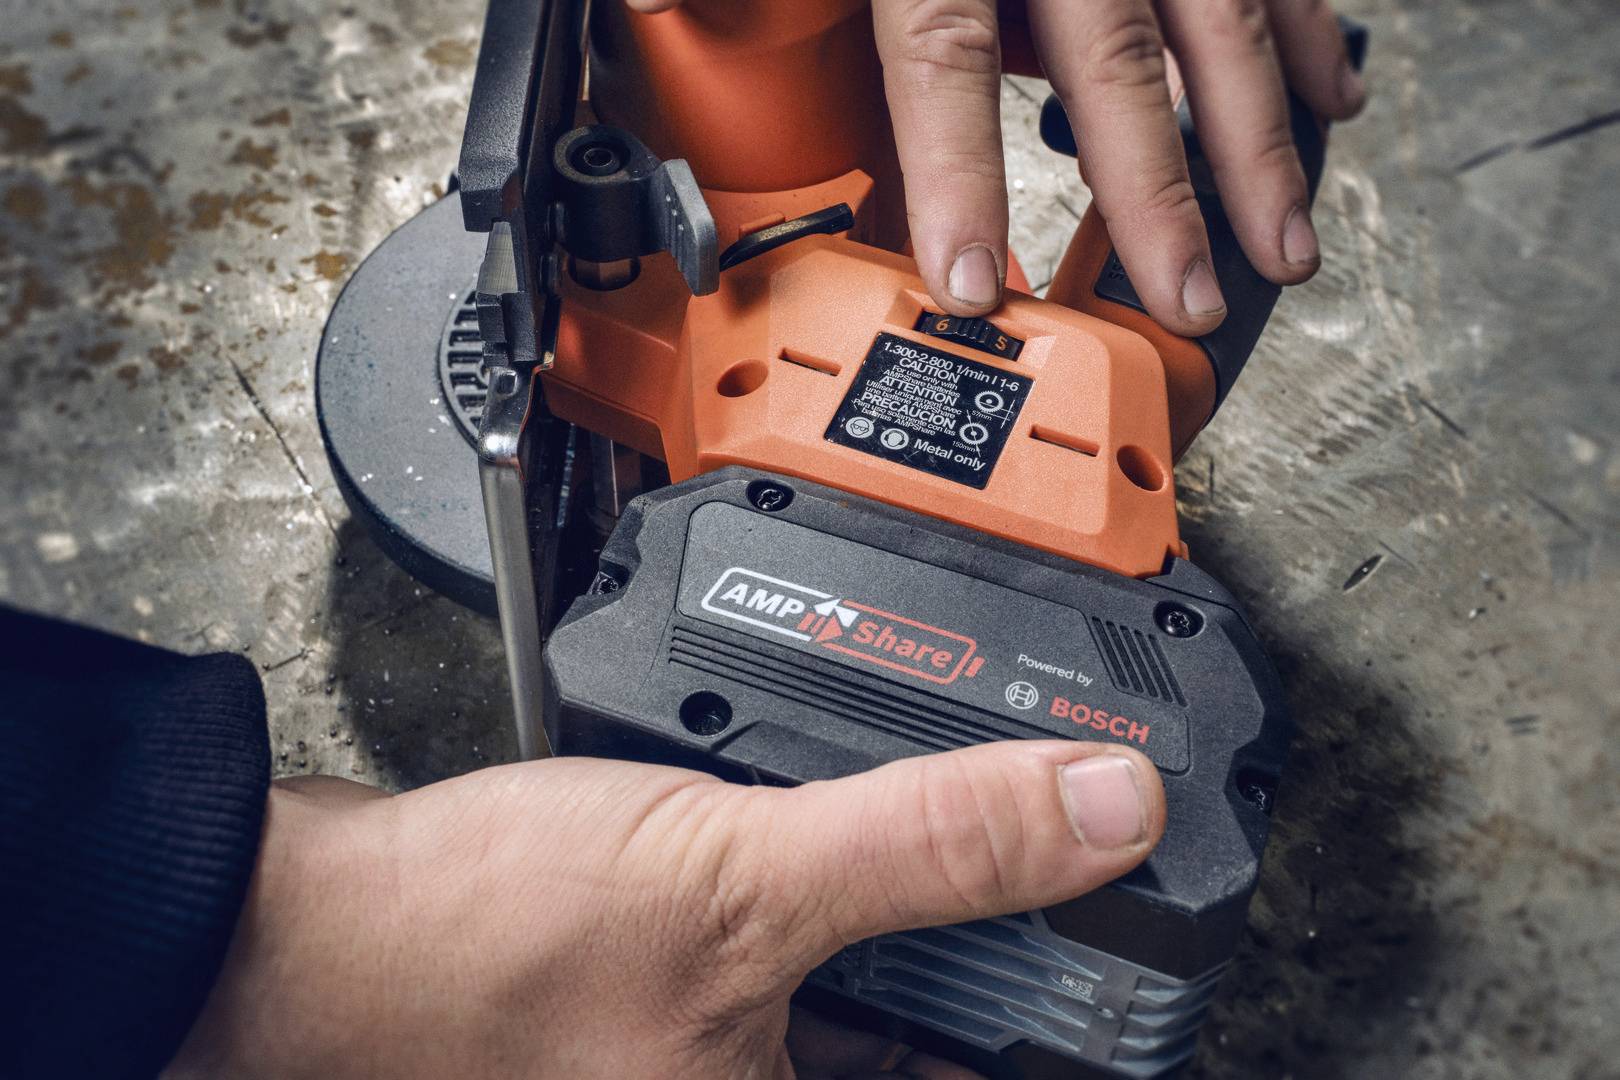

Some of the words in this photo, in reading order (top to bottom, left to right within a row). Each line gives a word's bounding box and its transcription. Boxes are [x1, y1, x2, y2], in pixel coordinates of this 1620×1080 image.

[936, 319, 949, 331] 6
[884, 342, 954, 371] 1.300-2.800
[957, 364, 990, 383] 1/min
[1000, 378, 1020, 392] 1-6
[892, 364, 906, 374] For
[906, 370, 921, 379] use
[922, 375, 940, 386] only
[940, 381, 958, 391] with
[899, 357, 960, 384] CAUTION
[866, 379, 895, 393] Utiliser
[894, 390, 942, 408] uniquement
[942, 405, 962, 415] avec
[880, 375, 958, 407] ATTENTION
[883, 369, 926, 387] AMPShare
[926, 383, 961, 399] batteries
[853, 398, 870, 409] Para
[871, 404, 887, 414] uso
[886, 410, 928, 427] solamente
[927, 423, 943, 433] con
[943, 428, 956, 437] las
[861, 391, 957, 430] PRECAUCION
[865, 386, 882, 396] une
[881, 391, 912, 405] batterie
[912, 401, 956, 419] AMPShare
[893, 418, 936, 436] AMPShare
[913, 438, 954, 460] Metal
[954, 454, 987, 471] only
[952, 440, 976, 453] 150mm
[720, 583, 805, 617] AMP
[853, 621, 953, 668] Share
[1017, 653, 1075, 680] Powered
[1076, 672, 1093, 687] by
[1050, 696, 1150, 744] BOSCH
